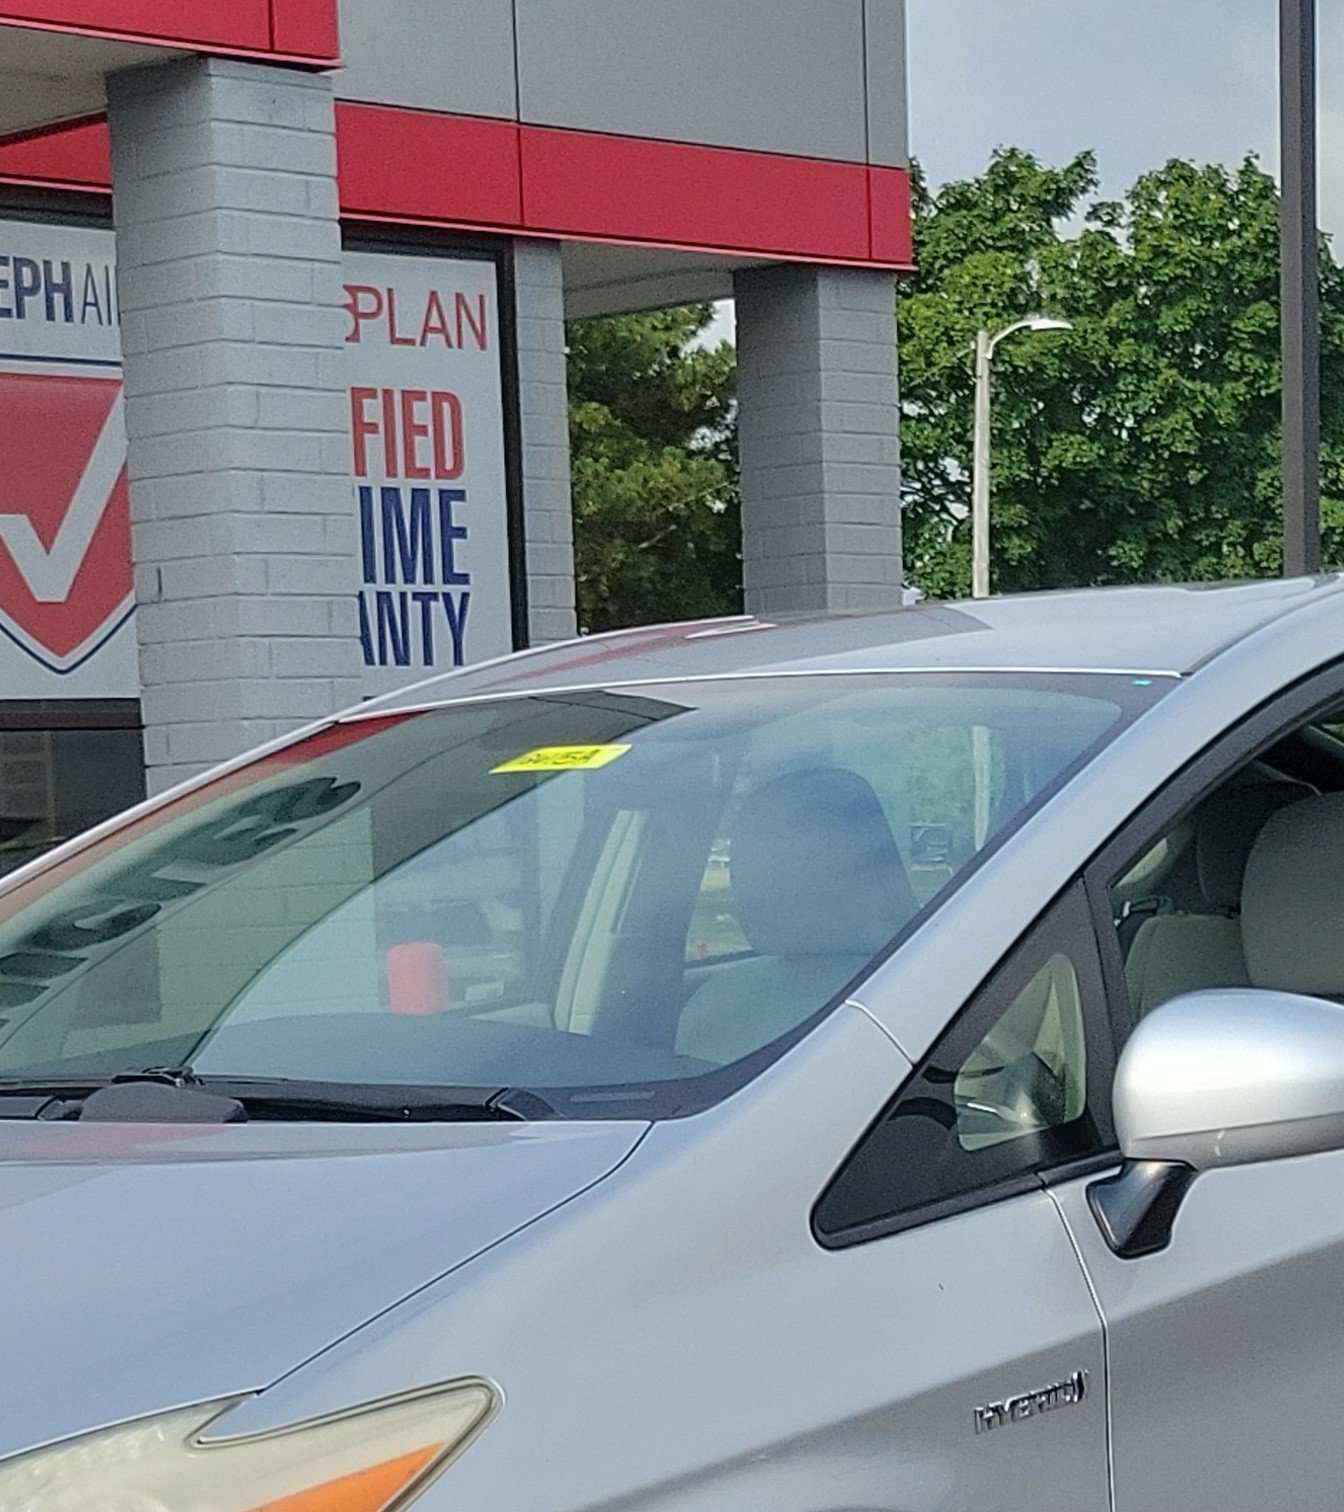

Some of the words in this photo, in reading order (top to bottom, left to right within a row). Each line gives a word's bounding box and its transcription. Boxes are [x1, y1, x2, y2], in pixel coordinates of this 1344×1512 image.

[343, 283, 488, 351] PLAN
[350, 386, 466, 481] FIED
[358, 485, 471, 586] IME
